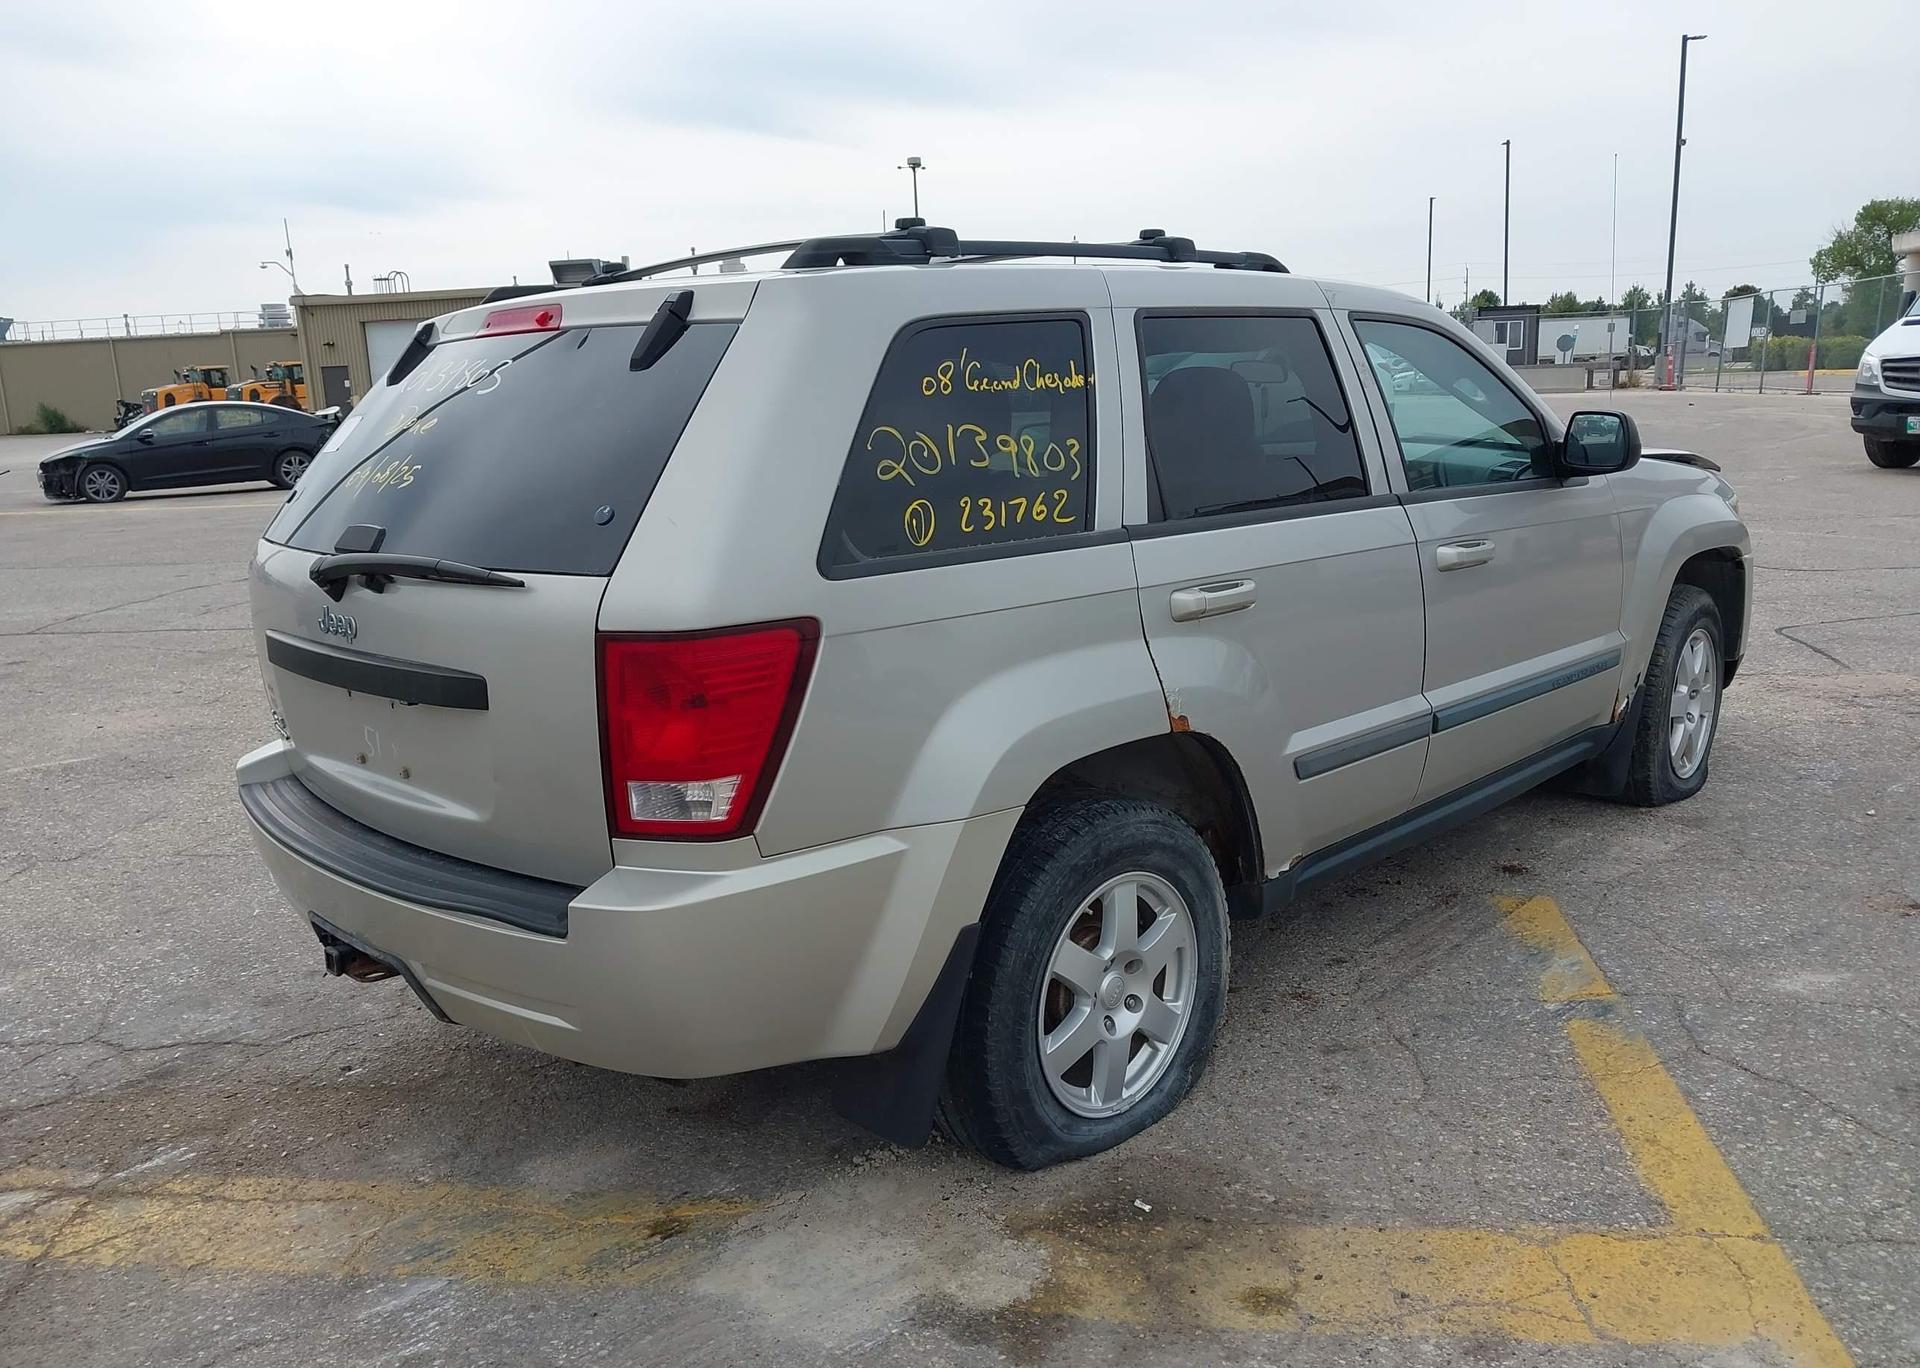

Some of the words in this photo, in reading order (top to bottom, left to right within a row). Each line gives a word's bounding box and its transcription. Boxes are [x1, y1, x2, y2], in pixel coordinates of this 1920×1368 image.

[866, 423, 1082, 487] 20139803
[959, 489, 1077, 533] 231762
[317, 606, 358, 645] Jeep
